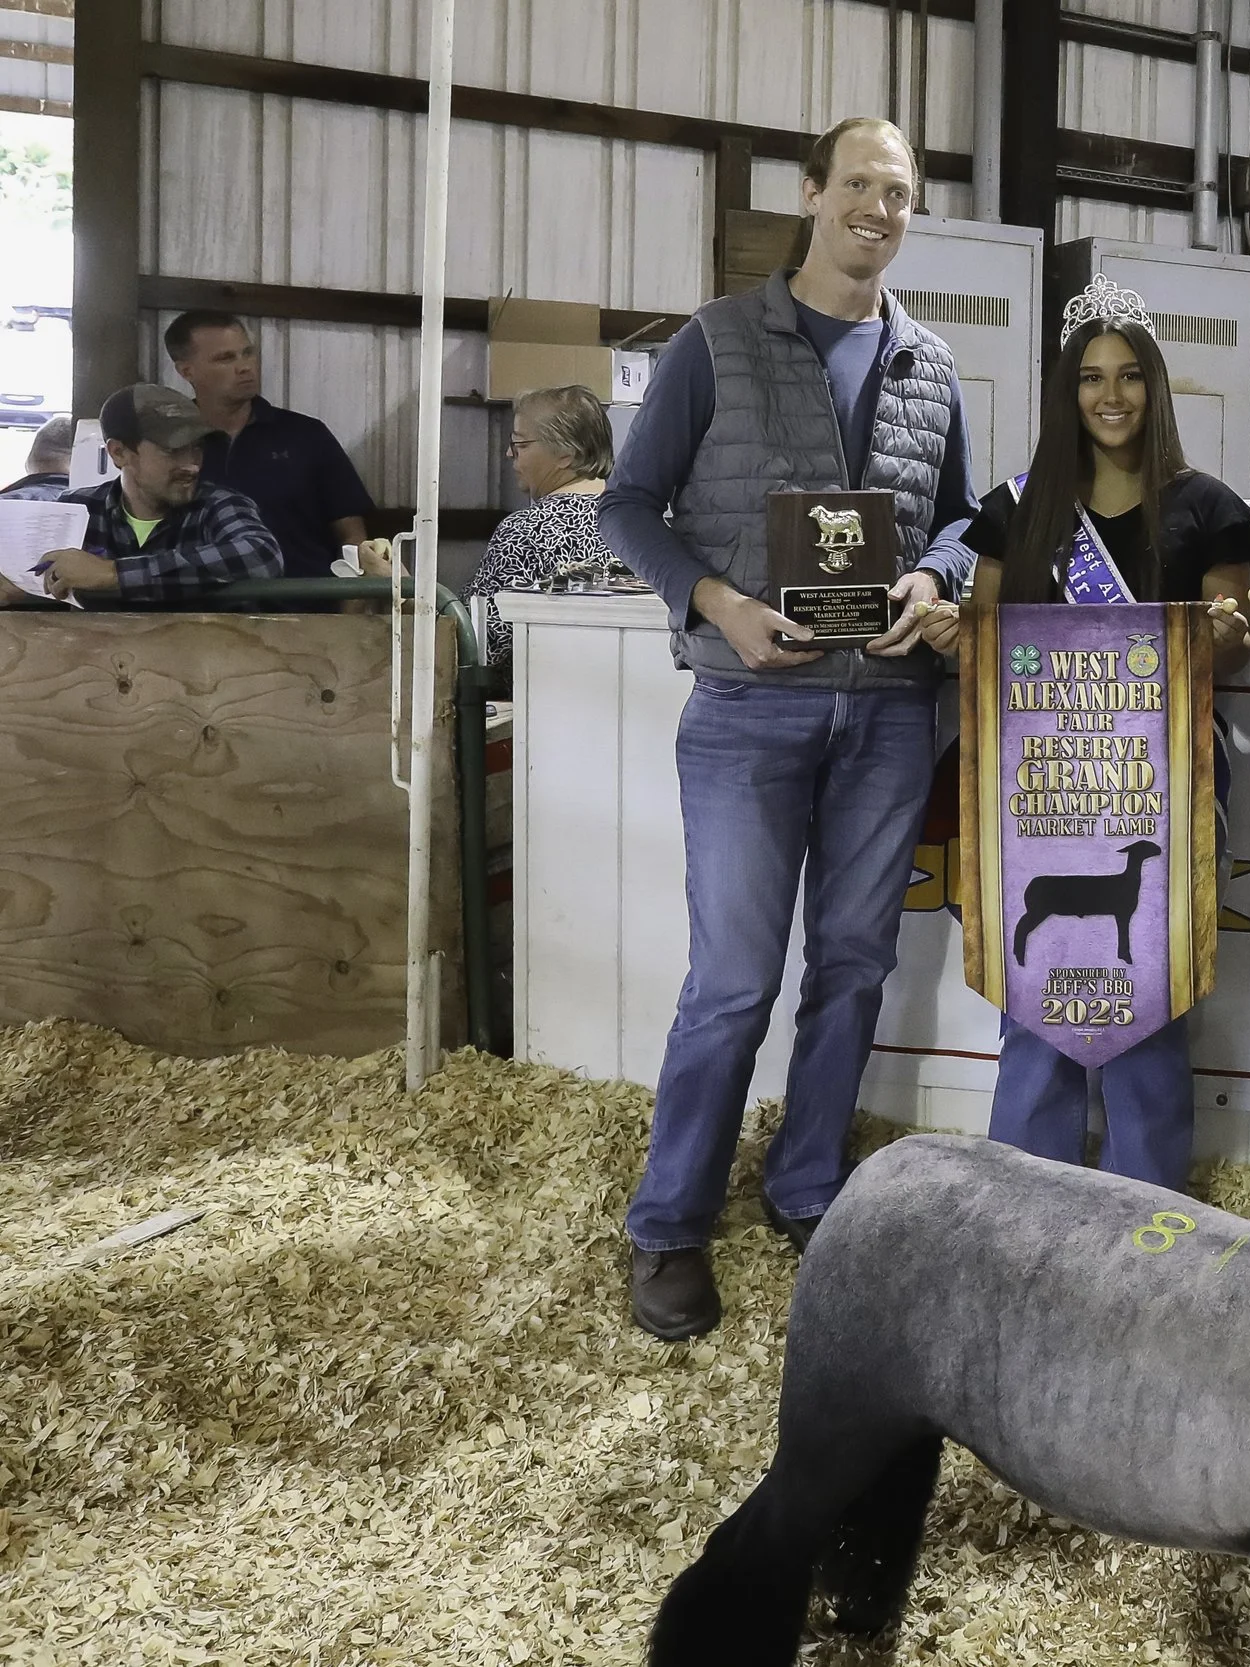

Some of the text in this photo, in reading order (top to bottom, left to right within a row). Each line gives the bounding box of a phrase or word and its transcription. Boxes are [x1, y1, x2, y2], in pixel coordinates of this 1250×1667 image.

[1072, 526, 1102, 571] West
[1050, 651, 1120, 680] WEST
[1008, 682, 1162, 711] ALEXANDER
[1057, 712, 1114, 731] FAIR
[1022, 736, 1148, 760] RESERVE
[1016, 760, 1154, 792] GRAND
[1009, 792, 1162, 816] CHAMPION
[1018, 818, 1156, 836] MARKET LAMB
[1049, 968, 1126, 978] SPONSORED BY
[1041, 979, 1134, 996] JEFF'S BBQ
[1042, 998, 1134, 1026] 2025
